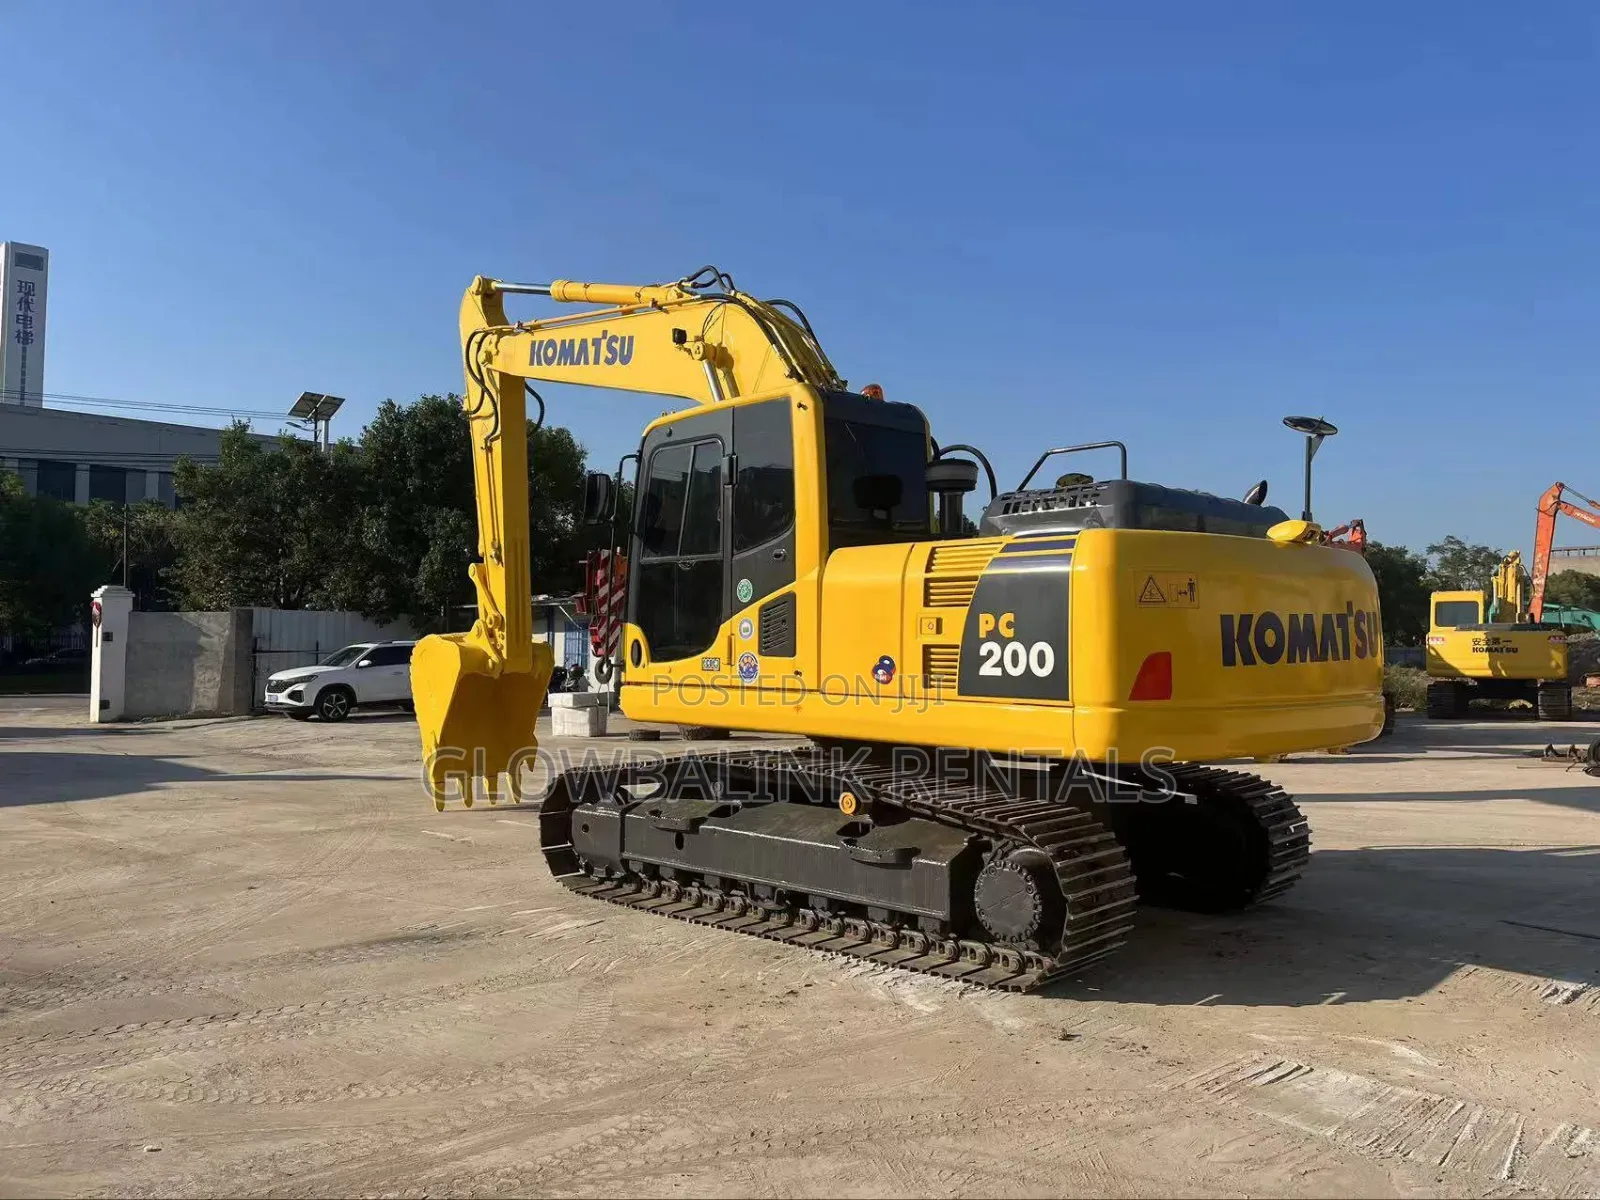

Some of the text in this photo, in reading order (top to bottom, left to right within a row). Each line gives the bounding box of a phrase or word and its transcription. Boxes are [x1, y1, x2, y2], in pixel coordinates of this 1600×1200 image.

[15, 279, 36, 345] 现代电梯
[979, 612, 1015, 639] PC
[979, 641, 1055, 677] 200
